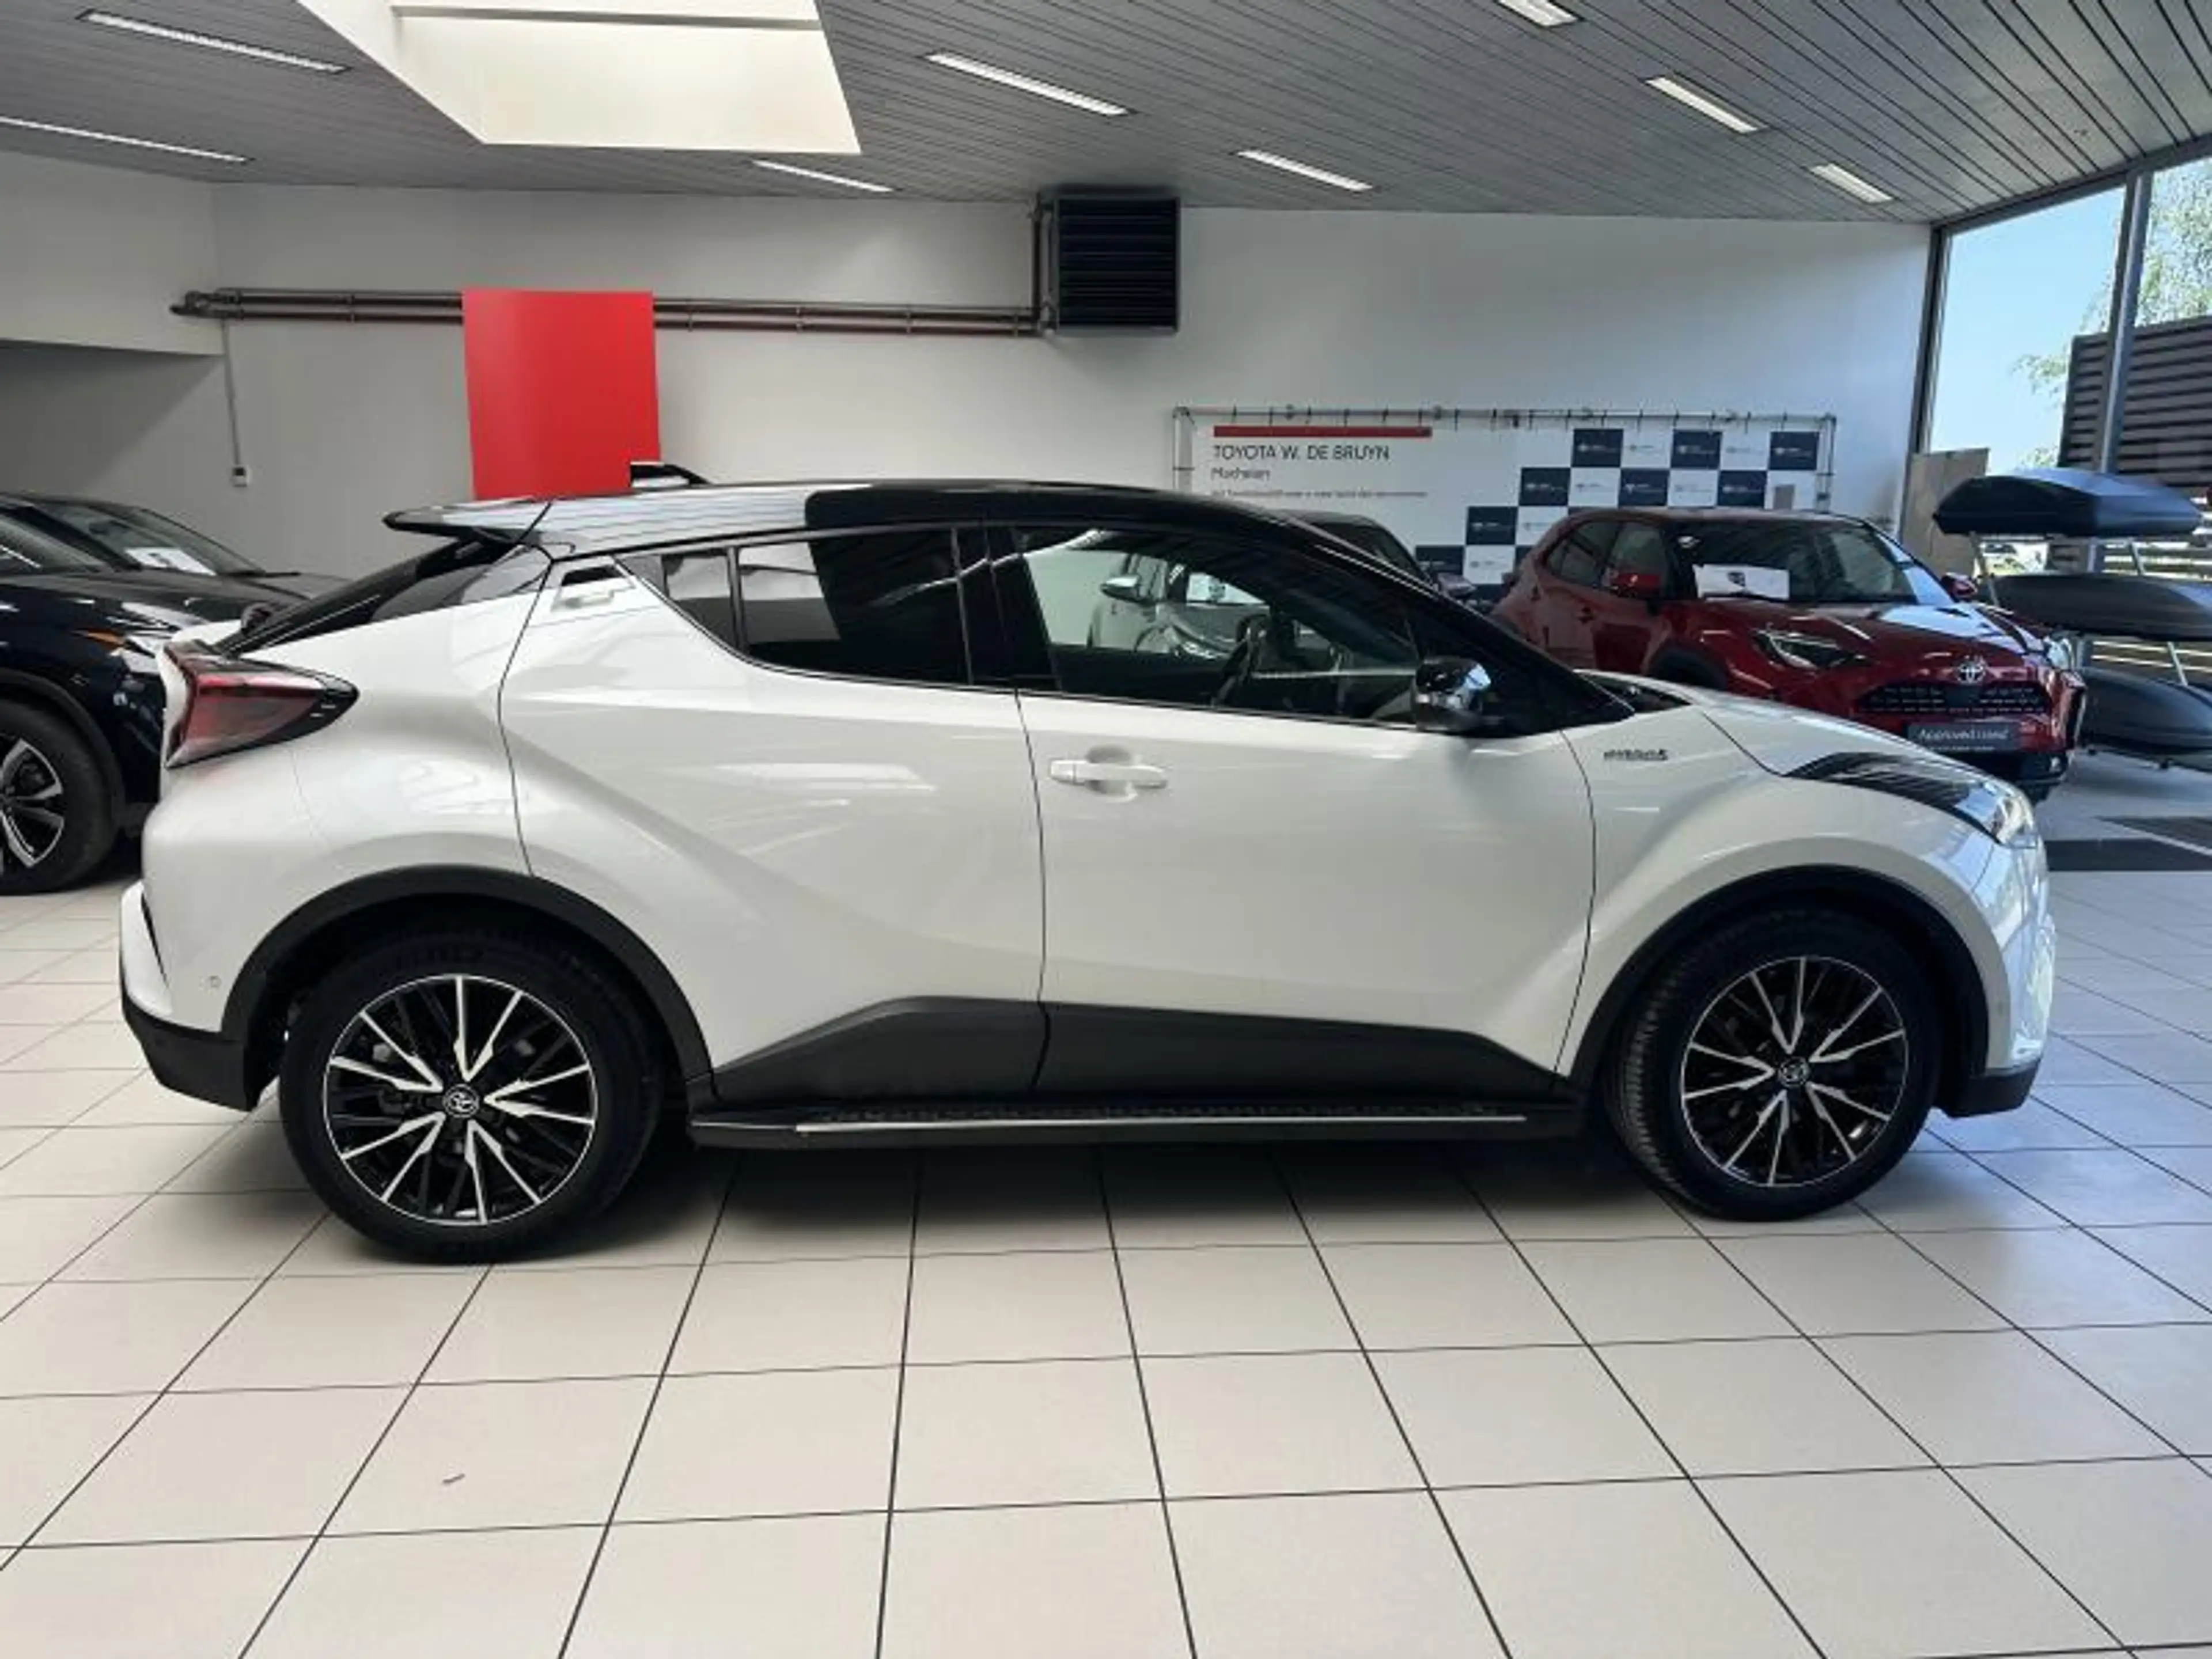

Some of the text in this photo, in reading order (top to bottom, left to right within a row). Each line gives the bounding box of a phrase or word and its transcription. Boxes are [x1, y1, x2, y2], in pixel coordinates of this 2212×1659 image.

[1213, 445, 1275, 460] TOYOTA
[1307, 445, 1328, 460] DE
[1333, 445, 1389, 460] BRUYN
